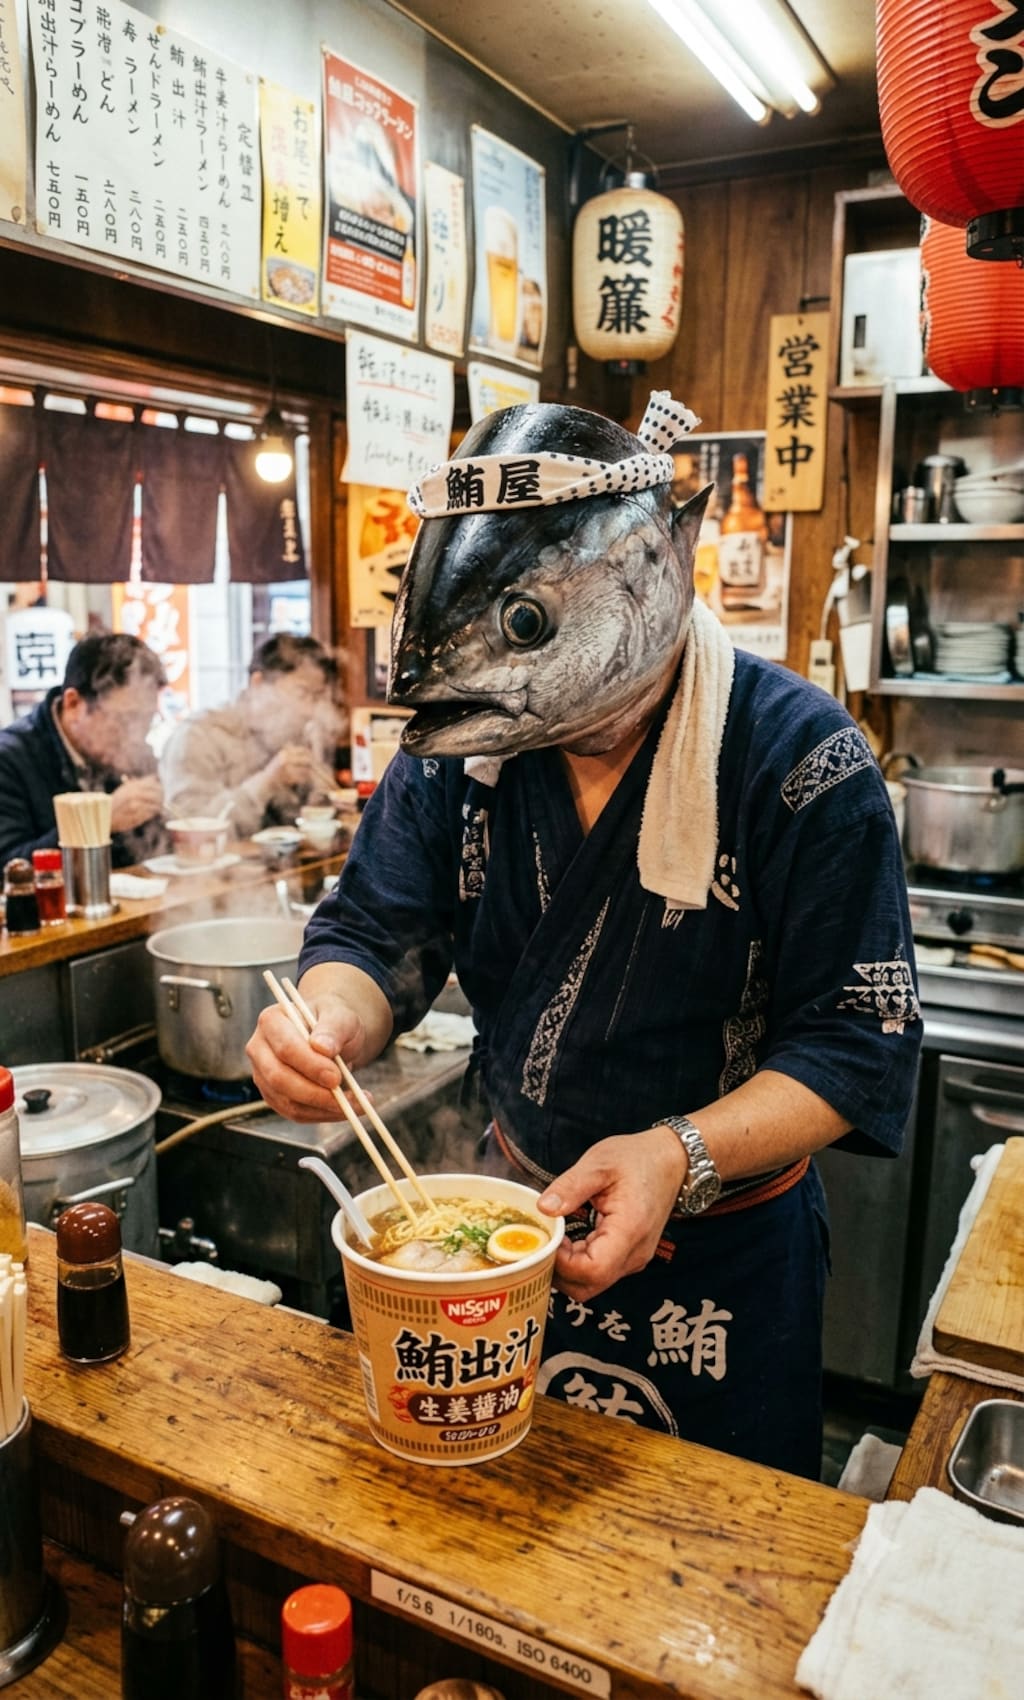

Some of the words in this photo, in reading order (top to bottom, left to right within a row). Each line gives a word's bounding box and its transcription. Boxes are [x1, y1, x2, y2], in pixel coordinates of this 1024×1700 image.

[596, 208, 653, 335] 暖簾
[775, 333, 820, 478] 営業中
[445, 459, 543, 511] 鮪屋
[447, 1298, 501, 1318] NISSIN
[647, 1299, 733, 1381] 鮪
[394, 1318, 541, 1388] 鮪出汁
[516, 1638, 546, 1664] ISO
[549, 1654, 593, 1684] 6400
